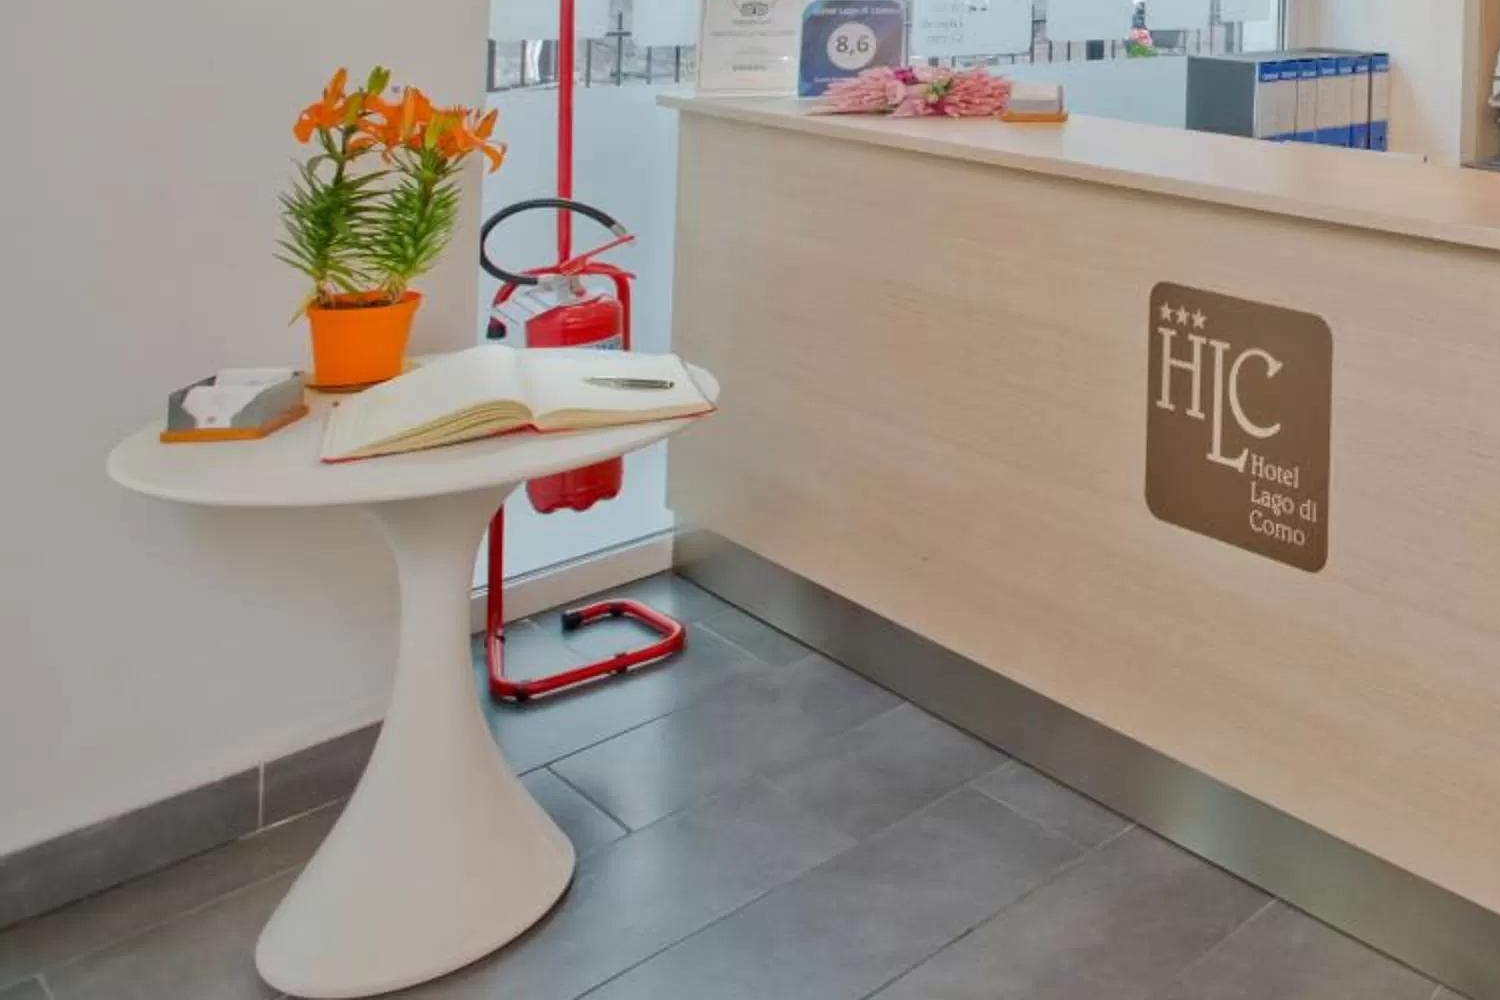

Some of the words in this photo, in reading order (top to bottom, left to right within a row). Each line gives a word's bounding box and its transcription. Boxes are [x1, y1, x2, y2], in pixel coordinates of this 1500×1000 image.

[836, 34, 870, 56] 8,6
[1251, 453, 1299, 488] Hotel
[1250, 481, 1295, 517] Lago
[1299, 499, 1317, 523] di
[1250, 510, 1305, 546] Como
